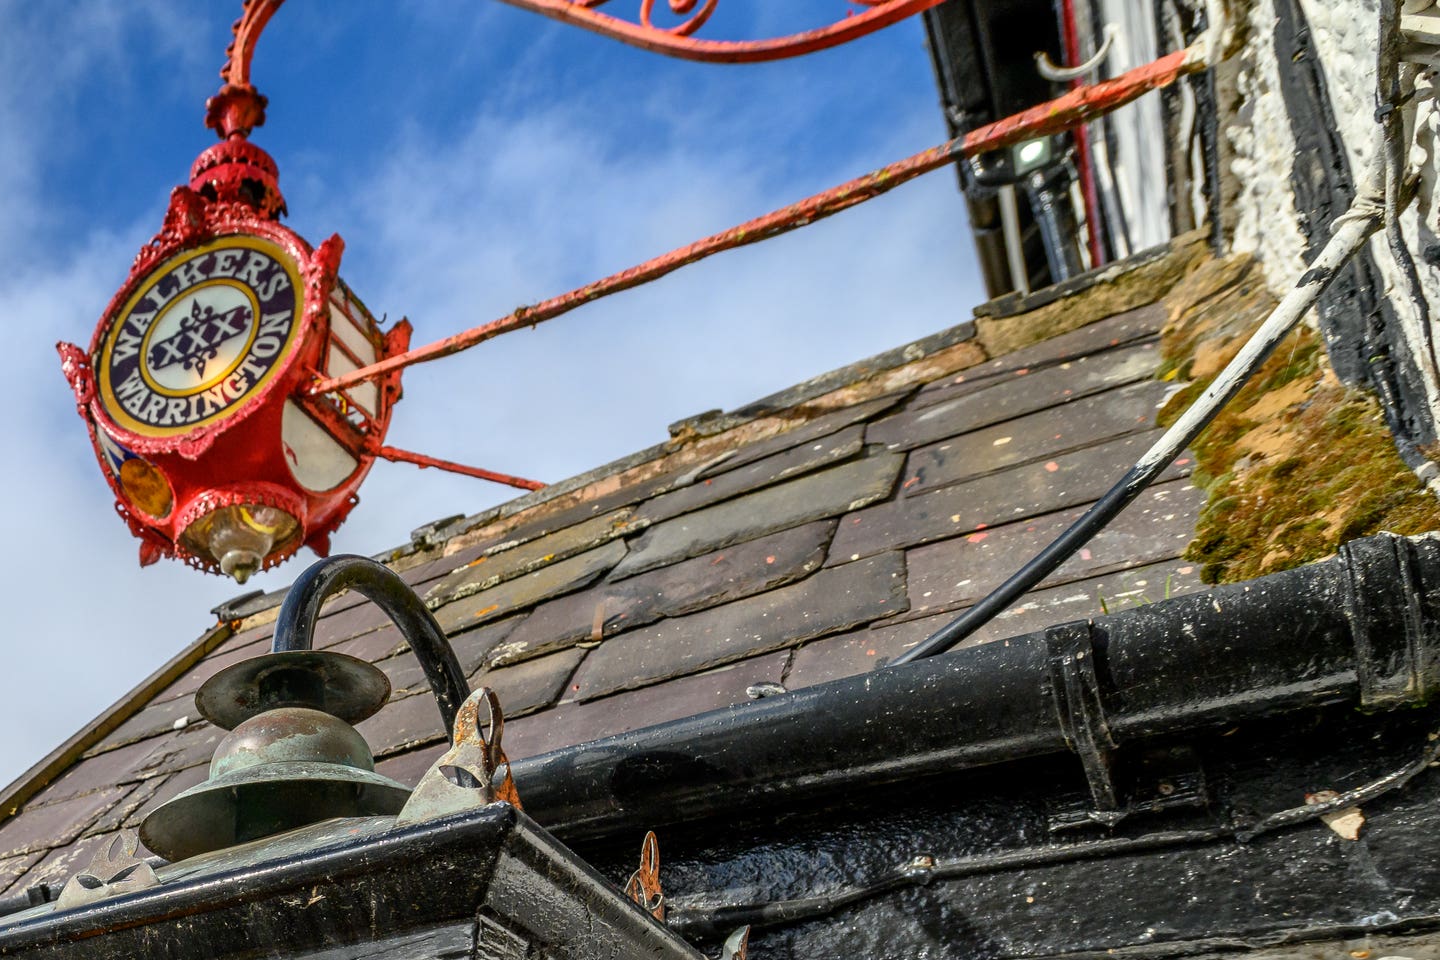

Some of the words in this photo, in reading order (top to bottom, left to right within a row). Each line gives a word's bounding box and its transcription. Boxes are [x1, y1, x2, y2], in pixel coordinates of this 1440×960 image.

[113, 249, 289, 367] WALKER'S
[160, 312, 240, 363] XXX
[115, 313, 290, 425] WARRINGTON
